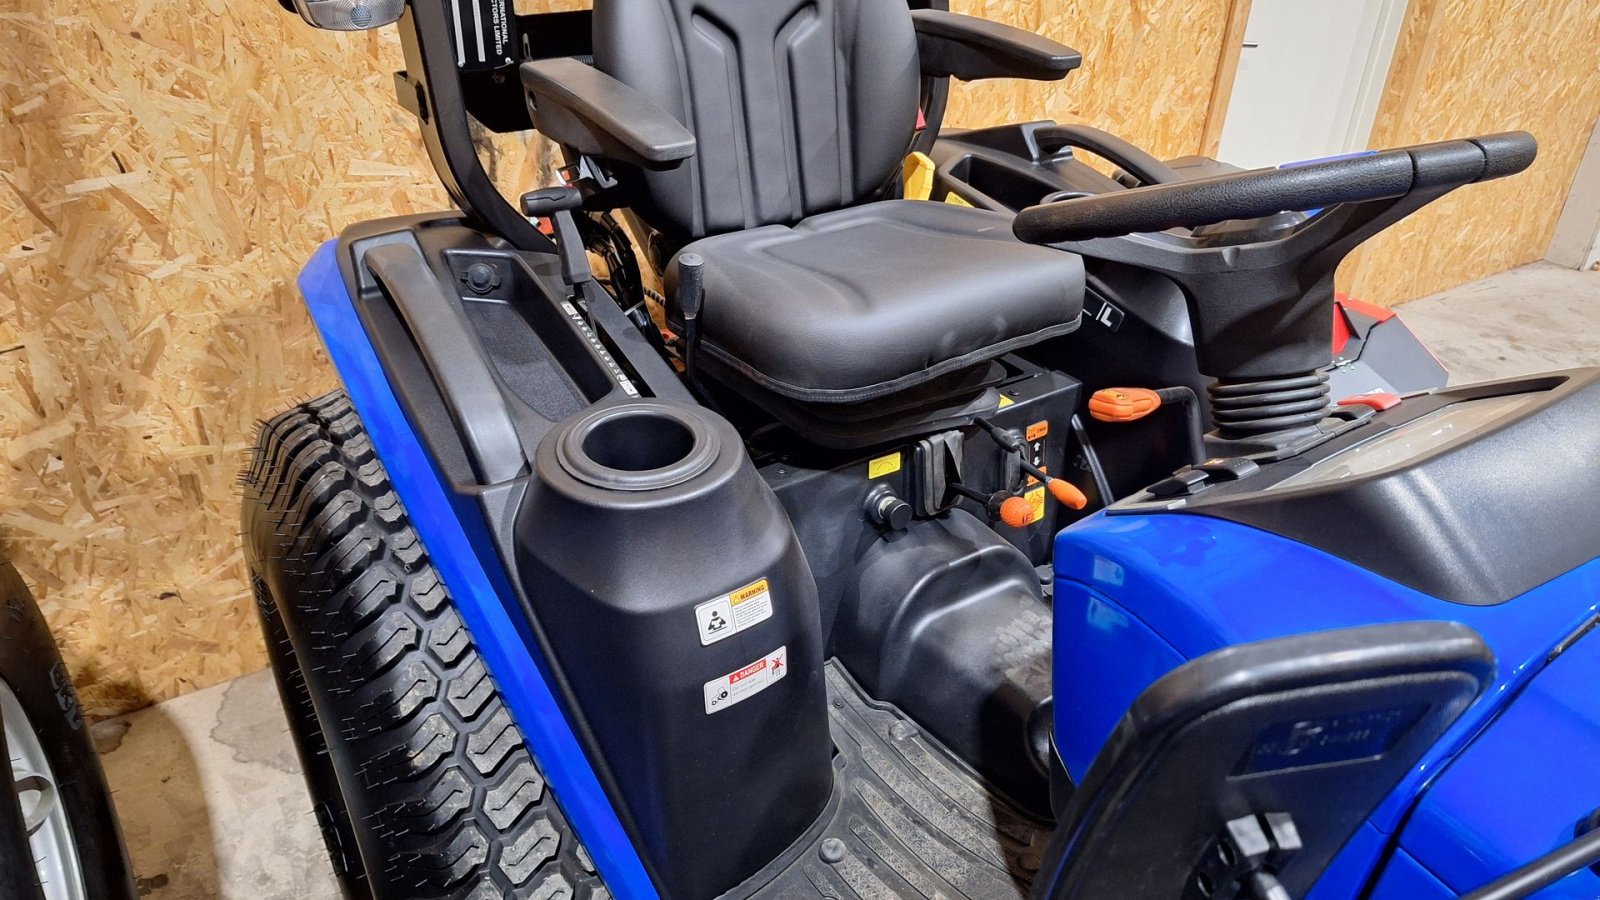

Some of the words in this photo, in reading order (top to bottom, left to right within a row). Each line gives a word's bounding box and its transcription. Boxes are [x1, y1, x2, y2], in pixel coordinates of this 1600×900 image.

[493, 26, 503, 55] LIMITED
[740, 585, 764, 600] WARNING
[740, 663, 764, 678] DANGER
